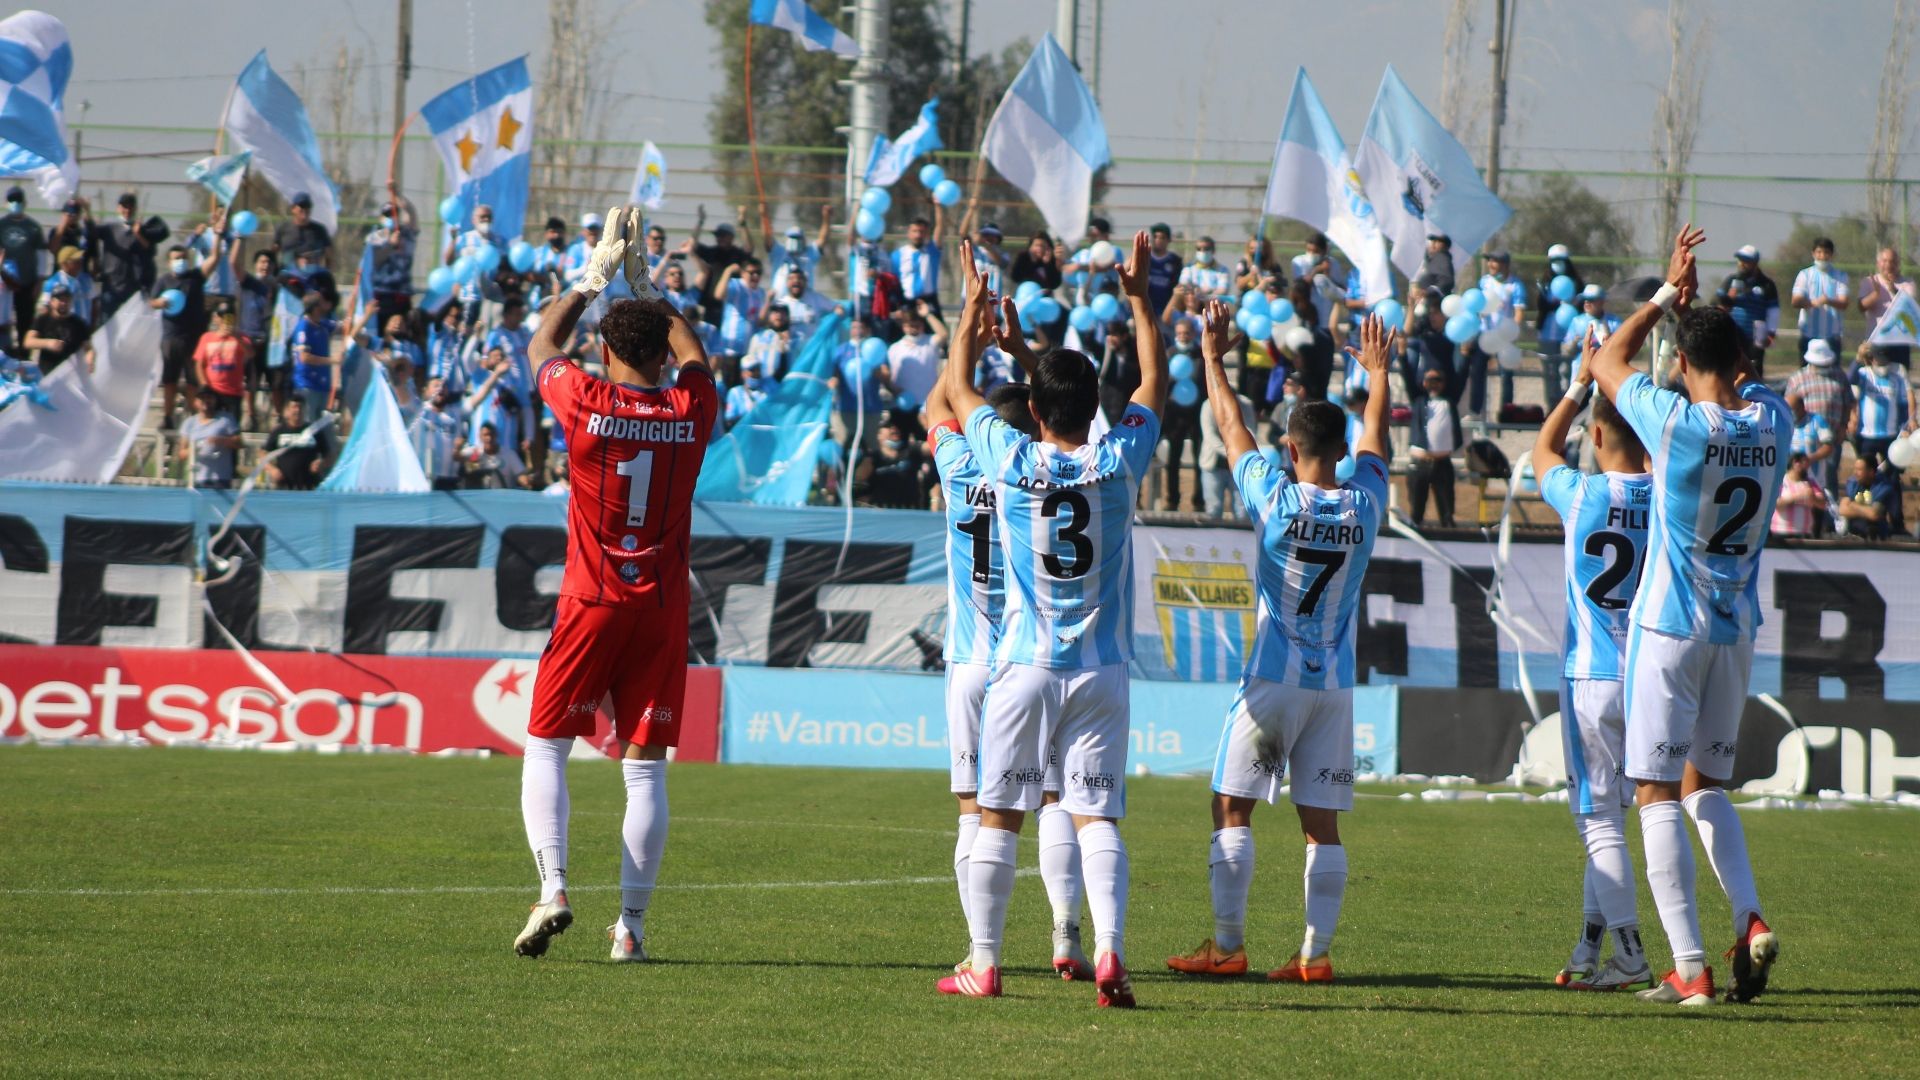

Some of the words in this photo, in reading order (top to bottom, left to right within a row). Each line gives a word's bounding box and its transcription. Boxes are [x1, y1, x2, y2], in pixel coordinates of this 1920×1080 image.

[586, 412, 696, 443] RODRIGUEZ
[1057, 462, 1076, 471] 125
[1704, 441, 1777, 468] PIÑERO
[616, 450, 654, 527] 1
[1630, 488, 1647, 497] 125
[1283, 518, 1364, 545] ALFARO
[1705, 476, 1762, 556] 2
[957, 513, 1003, 584] 1
[1041, 490, 1094, 579] 3
[1294, 547, 1347, 617] 7
[1584, 532, 1648, 609] 2
[653, 711, 673, 722] EDS
[747, 711, 946, 748] #VamosL
[1083, 776, 1115, 788] MEDS
